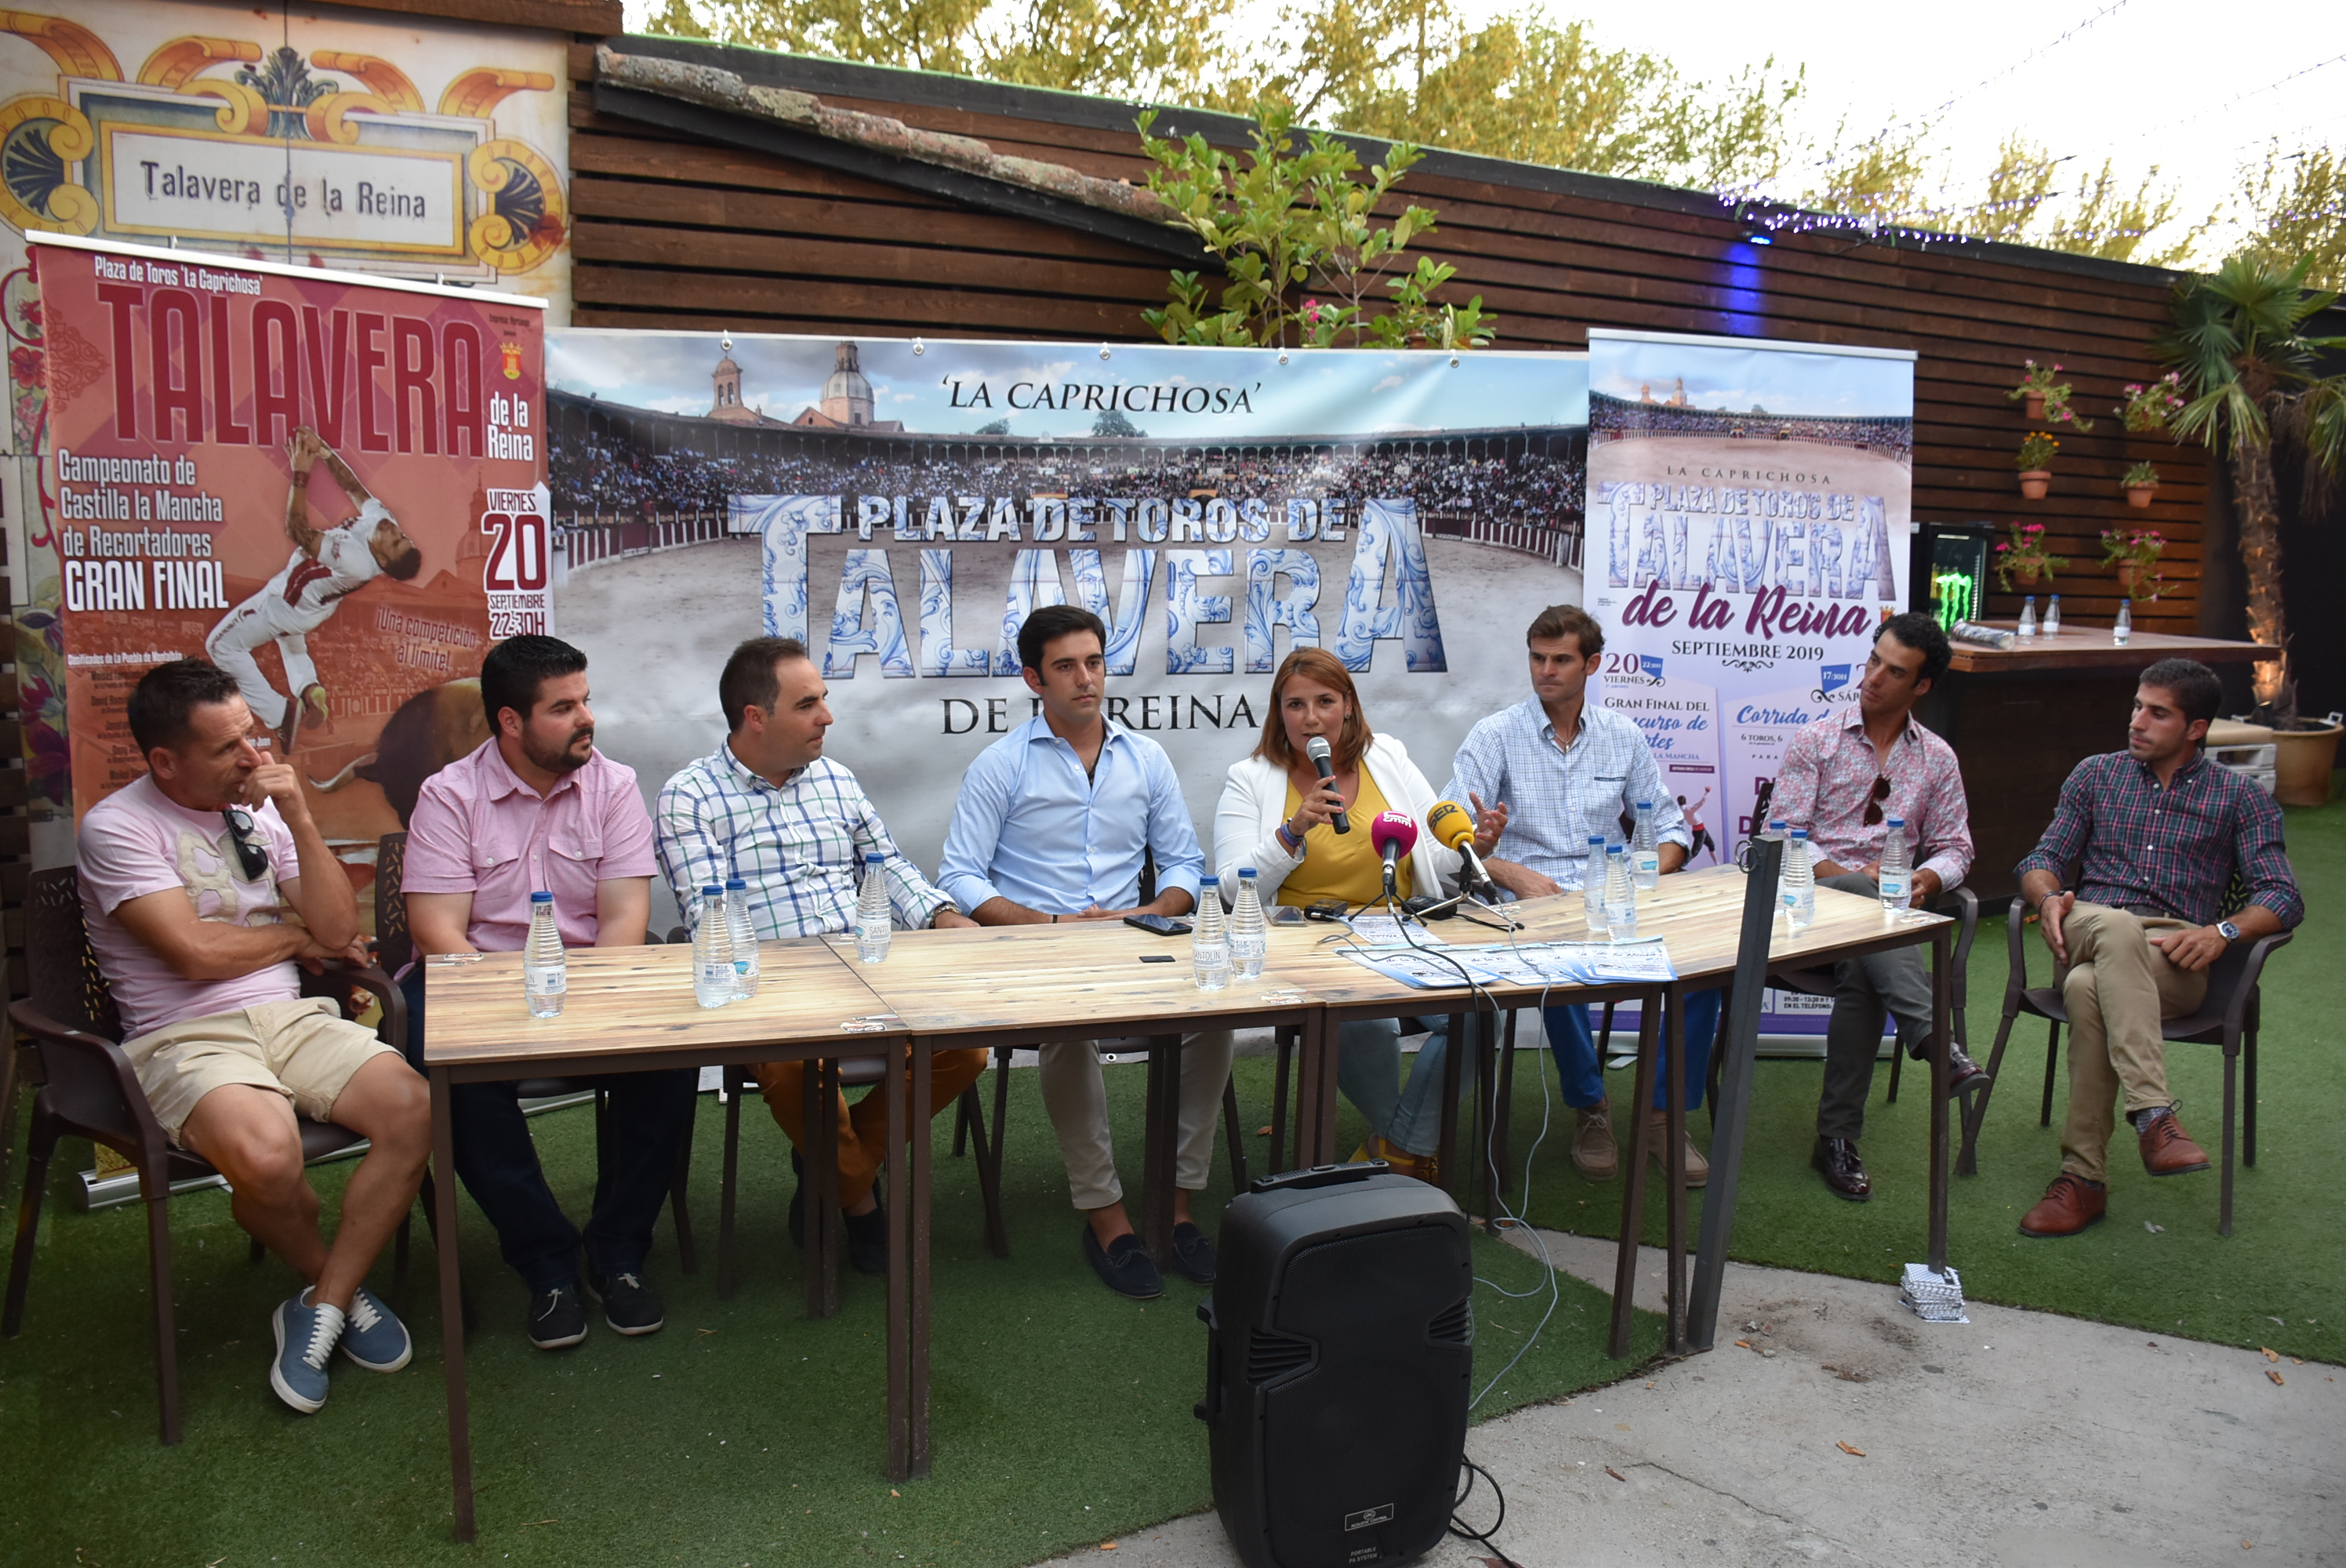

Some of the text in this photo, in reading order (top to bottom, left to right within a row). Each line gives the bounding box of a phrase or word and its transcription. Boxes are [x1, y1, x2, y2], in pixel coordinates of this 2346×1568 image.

[140, 159, 426, 218] Talavera de la Reina
[94, 255, 126, 280] Plaza
[129, 260, 144, 282] de
[146, 262, 179, 286] Toros
[97, 282, 485, 458] TALAVERA
[490, 390, 529, 428] de la
[487, 423, 534, 462] Reina
[58, 448, 196, 488] Campeonato de
[1667, 465, 1832, 485] LA CAPRICHOSA
[60, 486, 223, 522] Castilla la Mancha
[488, 491, 537, 512] VIERNES
[1651, 482, 1855, 522] PLAZA DE TOROS DE
[857, 495, 1347, 543] PLAZA DE TOROS DE
[62, 524, 212, 558] de Recortadores
[484, 514, 547, 591] 20
[1597, 481, 1897, 602] TALAVERA
[64, 560, 230, 612] GRAN FINAL
[489, 593, 545, 611] SEPTIEMBRE
[726, 494, 1448, 682] TALAVERA
[1622, 579, 1872, 641] de la Reina
[376, 606, 477, 650] ¡Una competición
[104, 652, 113, 664] de
[114, 652, 122, 664] La
[143, 651, 151, 662] de
[397, 641, 452, 673] al límite!
[1605, 652, 1639, 675] 20
[1671, 640, 1825, 662] SEPTIEMBRE 2019
[1604, 675, 1645, 684] VIERNES
[939, 698, 1009, 735] DE
[1106, 693, 1261, 731] REINA
[1604, 696, 1710, 712] GRAN FINAL DEL
[1736, 705, 1810, 725] Corrida
[1687, 714, 1709, 731] de
[1749, 735, 1776, 743] TOROS,
[1429, 804, 1459, 831] SER
[1350, 1519, 1370, 1529] ACOUSTIC
[1350, 1546, 1377, 1557] PORTABLE
[1356, 1552, 1378, 1562] SYSTEM
